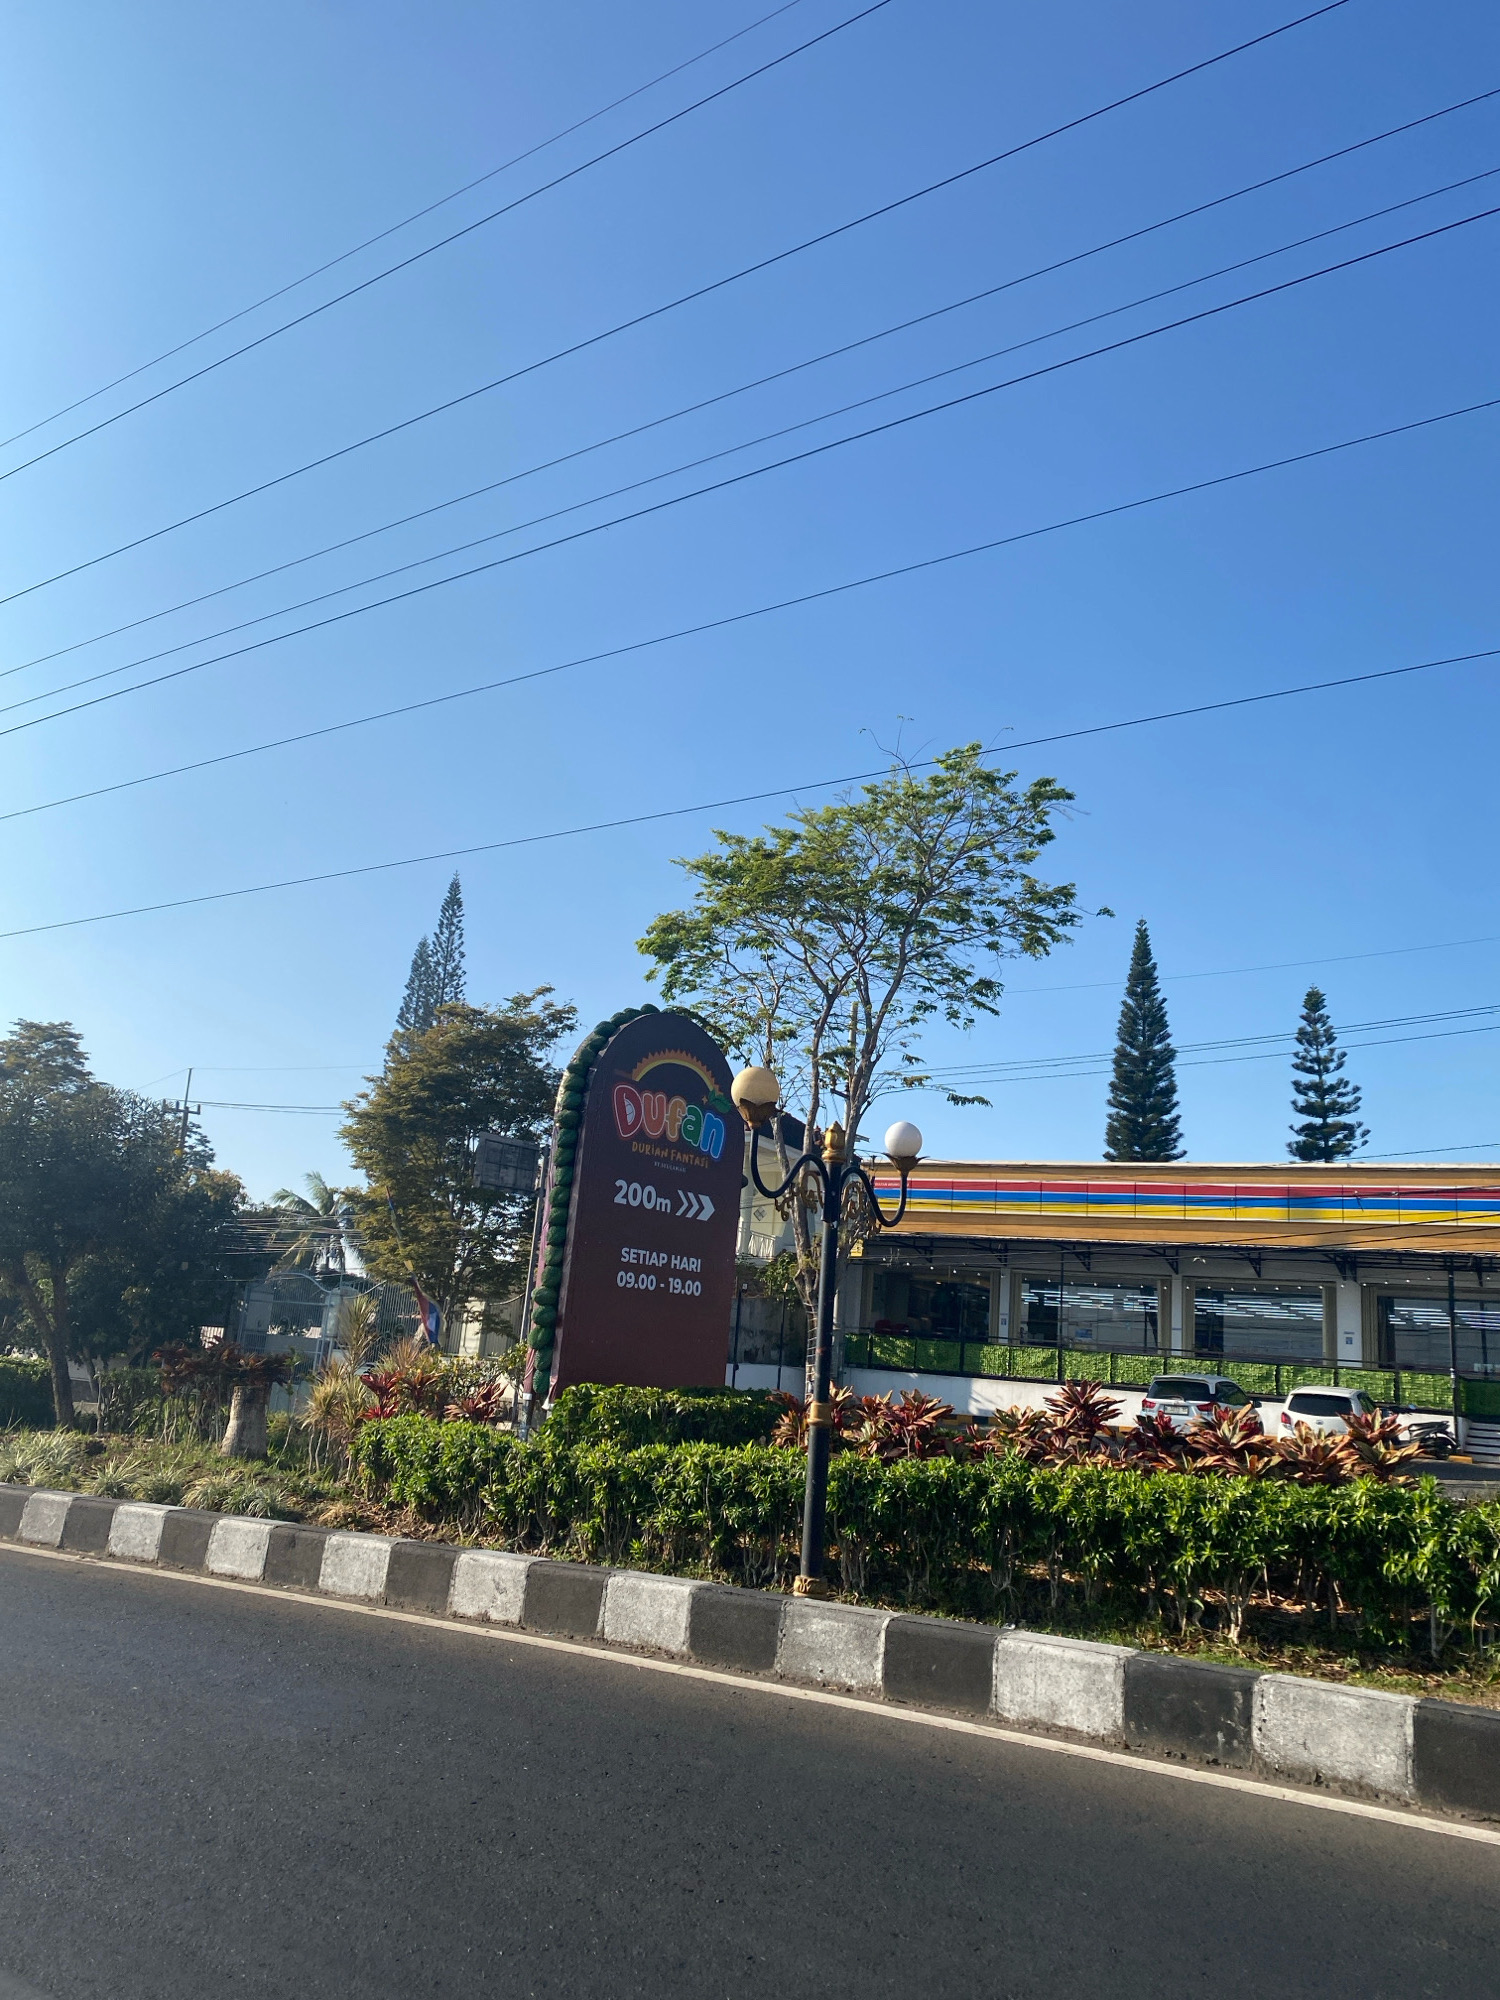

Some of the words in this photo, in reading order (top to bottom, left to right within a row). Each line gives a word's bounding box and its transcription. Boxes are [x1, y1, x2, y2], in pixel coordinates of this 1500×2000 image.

[613, 1084, 725, 1159] Dufan
[613, 1179, 672, 1213] 200m
[620, 1247, 668, 1267] SETIAP
[670, 1254, 701, 1273] HARI
[616, 1270, 657, 1291] 09.00
[668, 1277, 702, 1297] 19.00
